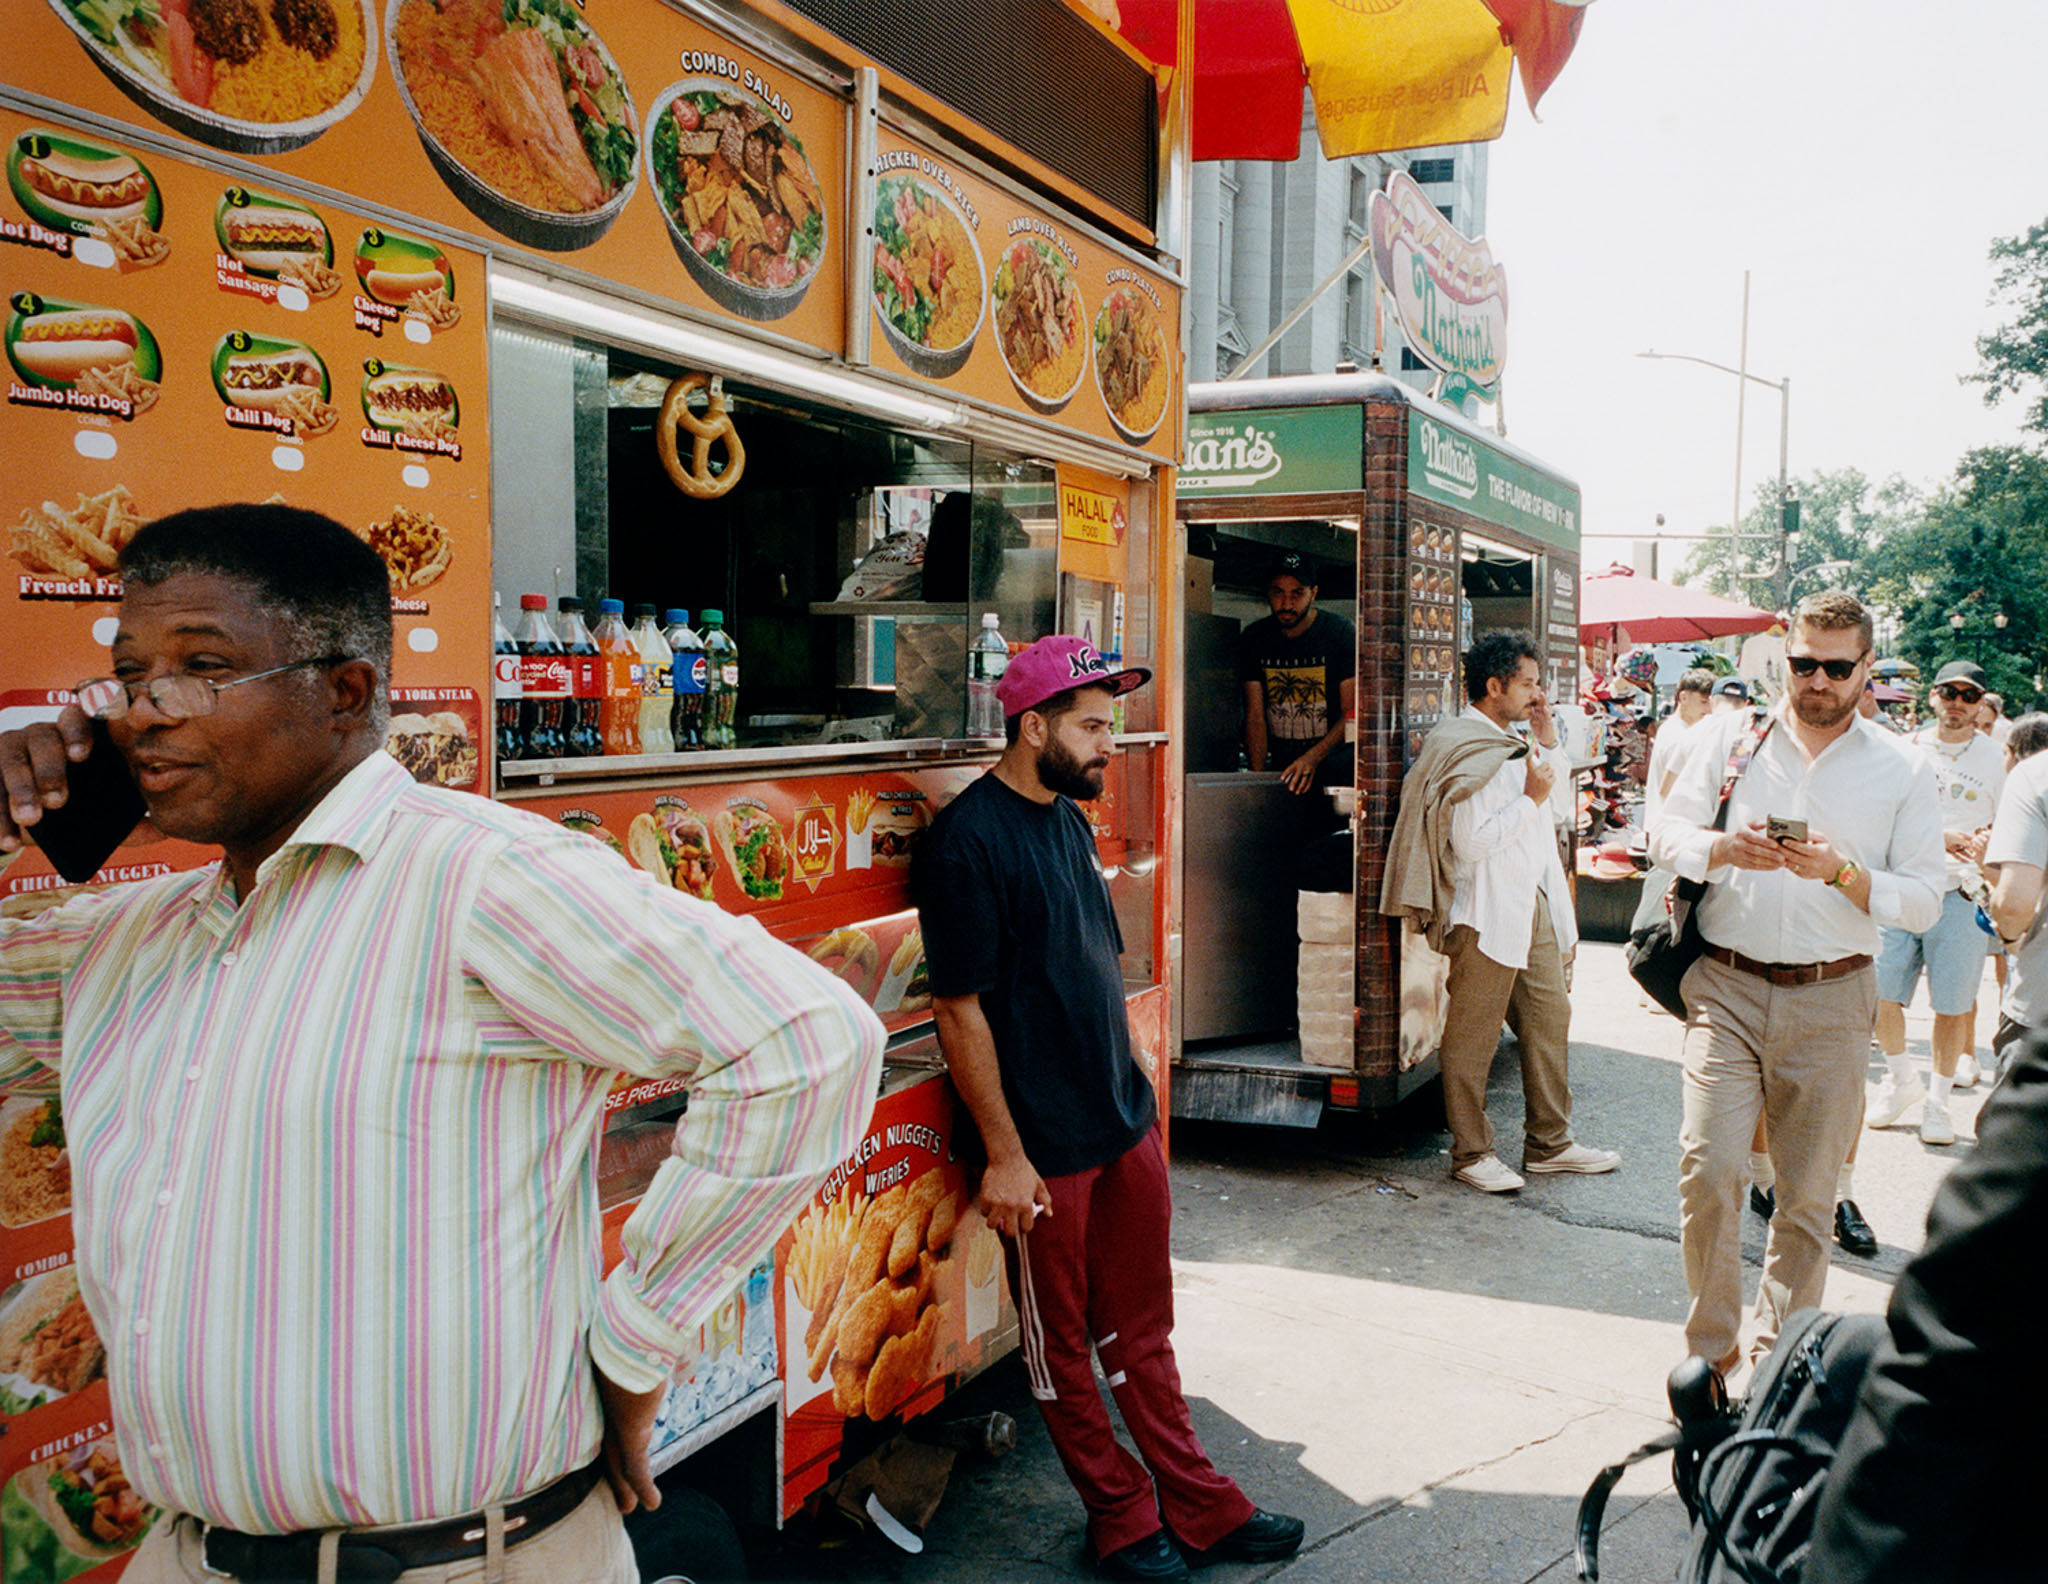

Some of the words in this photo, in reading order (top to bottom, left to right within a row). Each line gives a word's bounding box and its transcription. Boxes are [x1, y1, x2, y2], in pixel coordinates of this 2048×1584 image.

[681, 50, 739, 80] COMBO
[744, 69, 792, 122] SALAD
[30, 135, 39, 157] 1
[232, 187, 242, 205] 2
[875, 151, 919, 175] HICKEN
[922, 157, 952, 193] OVER
[954, 184, 980, 231] RICE
[30, 223, 68, 251] Dog
[369, 228, 379, 245] 3
[1007, 217, 1031, 236] LAMB
[1033, 218, 1056, 244] OVER
[1058, 236, 1079, 269] RICE
[216, 254, 243, 272] Hot
[1106, 268, 1131, 285] COMBO
[217, 271, 278, 297] Sausage
[19, 294, 35, 314] 4
[353, 295, 398, 318] Cheese
[355, 311, 381, 332] Dog
[233, 331, 245, 349] 5
[369, 358, 379, 375] 6
[8, 382, 64, 402] Jumbo
[67, 389, 96, 407] Hot
[100, 394, 130, 415] Dog
[225, 405, 260, 424] Chili
[263, 411, 291, 433] Dog
[361, 428, 391, 444] Chili
[395, 432, 435, 450] Cheese
[437, 438, 459, 457] Dog
[1420, 420, 1478, 486] Nathan's
[1066, 493, 1108, 524] HALAL
[1082, 524, 1099, 538] FOOD
[19, 576, 93, 594] French
[96, 578, 124, 595] Fri
[404, 688, 437, 701] YORK
[438, 688, 473, 701] STEAK
[798, 818, 832, 856] حلال
[10, 873, 90, 893] CHICK
[97, 862, 171, 885] NUGGETS
[603, 1090, 627, 1111] SE
[822, 1131, 881, 1206] CHICKEN
[886, 1123, 942, 1155] NUGGETS
[866, 1156, 910, 1194] W/FRIES
[15, 1251, 68, 1280] COMBO
[30, 1420, 109, 1463] CHICKEN
